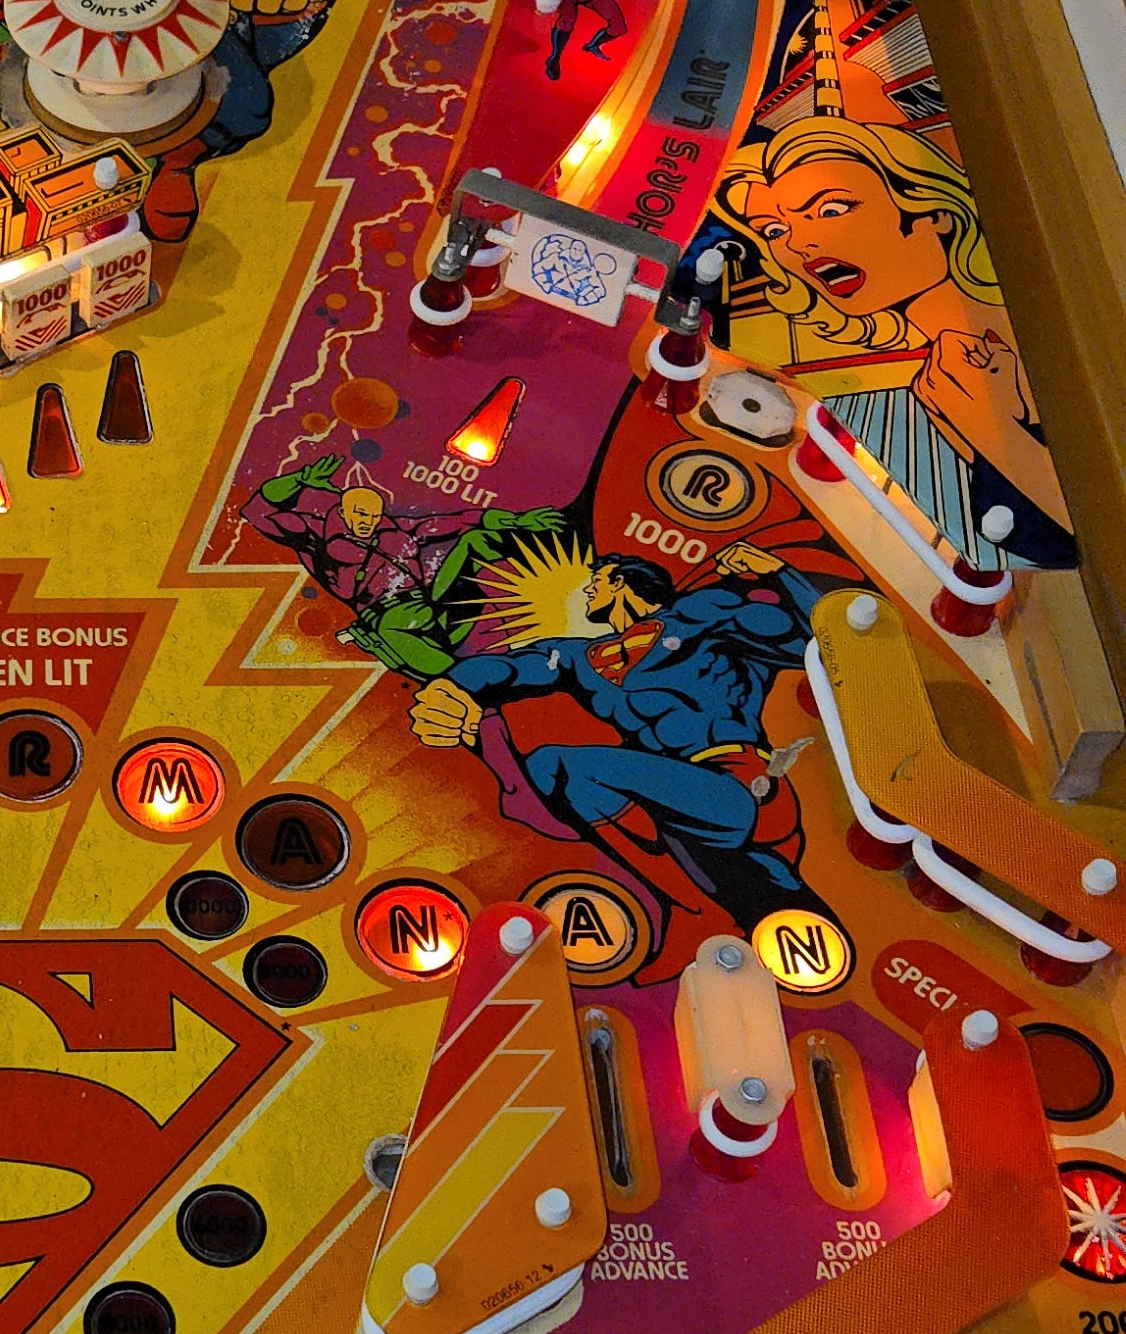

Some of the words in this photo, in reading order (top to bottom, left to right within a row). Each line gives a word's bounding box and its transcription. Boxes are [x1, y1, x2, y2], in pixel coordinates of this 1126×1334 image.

[96, 250, 147, 281] 1000
[16, 284, 68, 316] 1000
[403, 461, 459, 494] 1000
[460, 484, 498, 508] LIT
[438, 455, 479, 482] 100
[688, 466, 729, 503] R
[623, 512, 708, 565] 1000
[36, 627, 129, 647] BONUS
[44, 658, 93, 686] LIT
[8, 731, 51, 777] R
[137, 757, 205, 805] M
[273, 817, 322, 865] A
[388, 904, 439, 955] N
[561, 896, 614, 947] A
[776, 924, 831, 974] N
[883, 957, 958, 1011] SPECI
[610, 1223, 654, 1242] 500
[836, 1221, 881, 1240] 500
[596, 1241, 676, 1261] BONUS
[591, 1261, 689, 1281] ADVANCE
